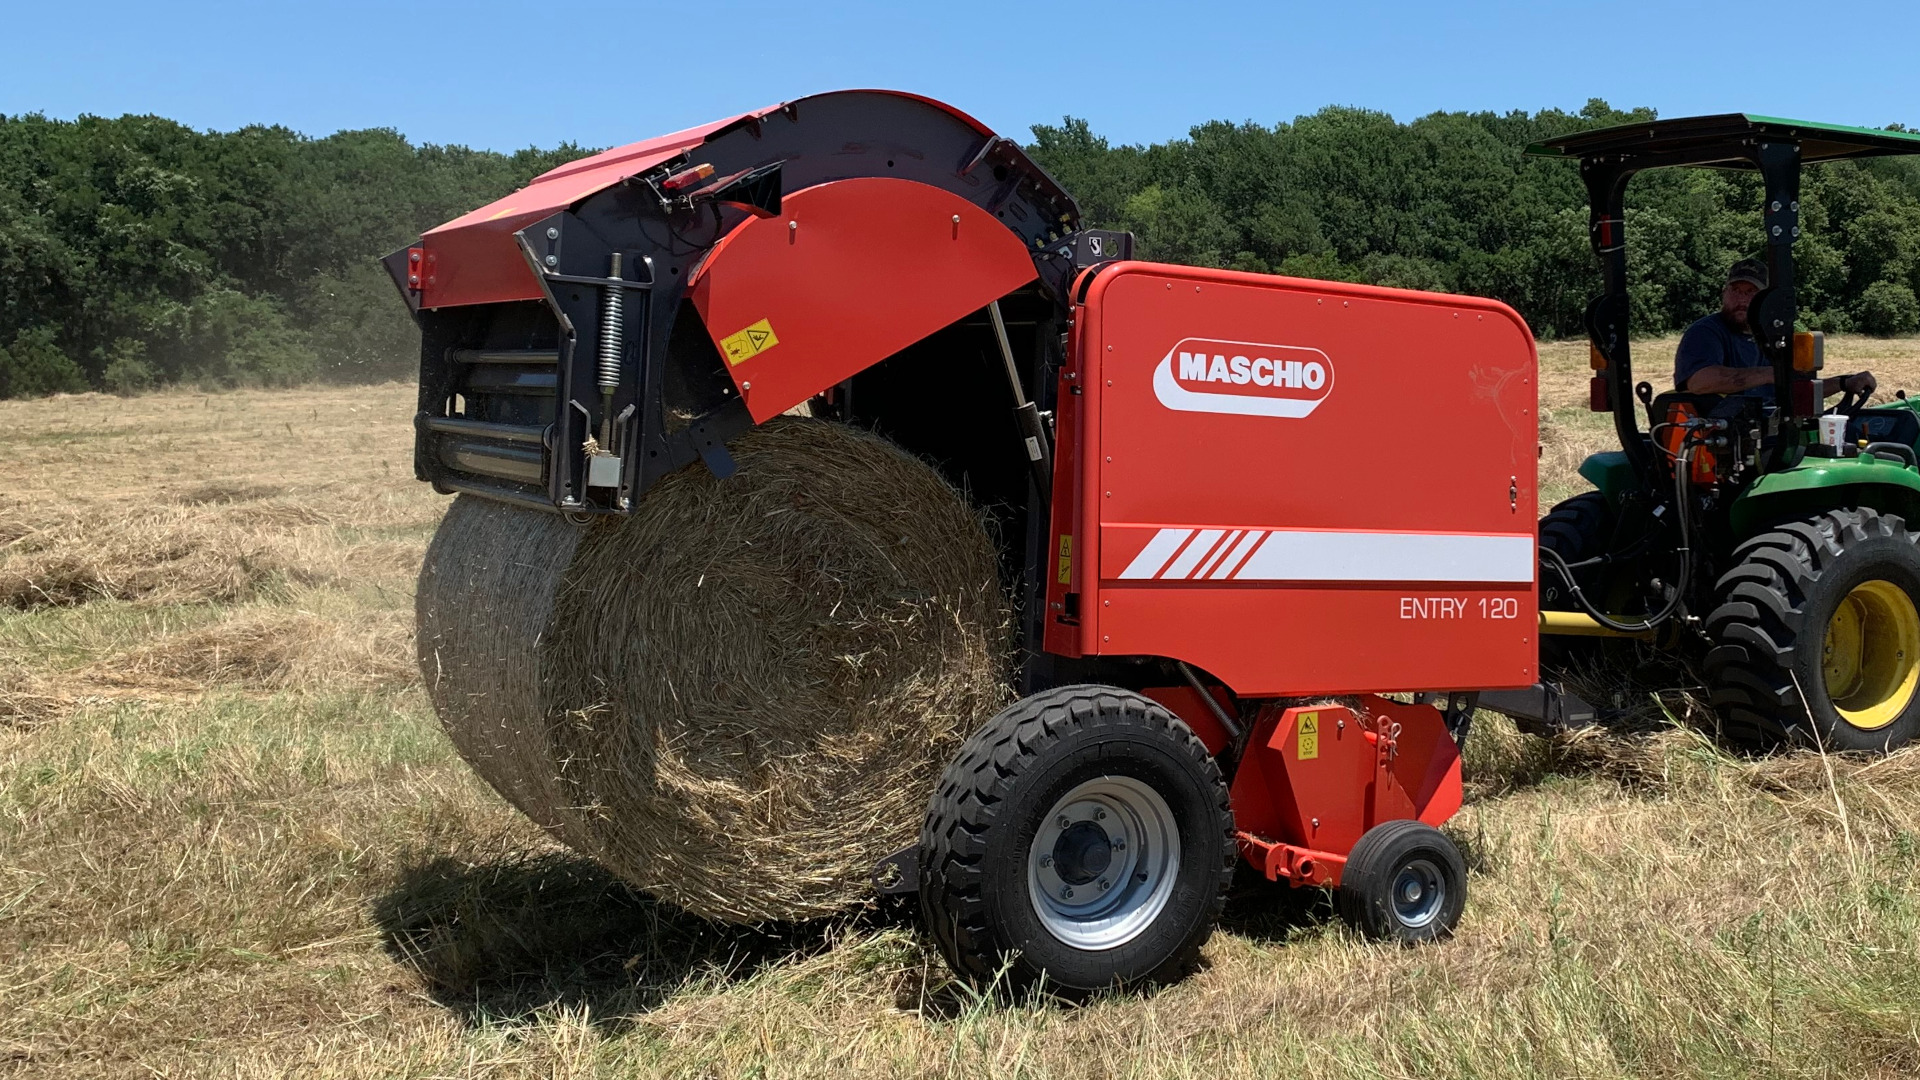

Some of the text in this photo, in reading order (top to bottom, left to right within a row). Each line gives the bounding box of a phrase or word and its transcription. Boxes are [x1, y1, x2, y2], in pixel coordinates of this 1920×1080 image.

[1179, 351, 1326, 390] MASCHIO
[1400, 597, 1518, 619] ENTRY 120
